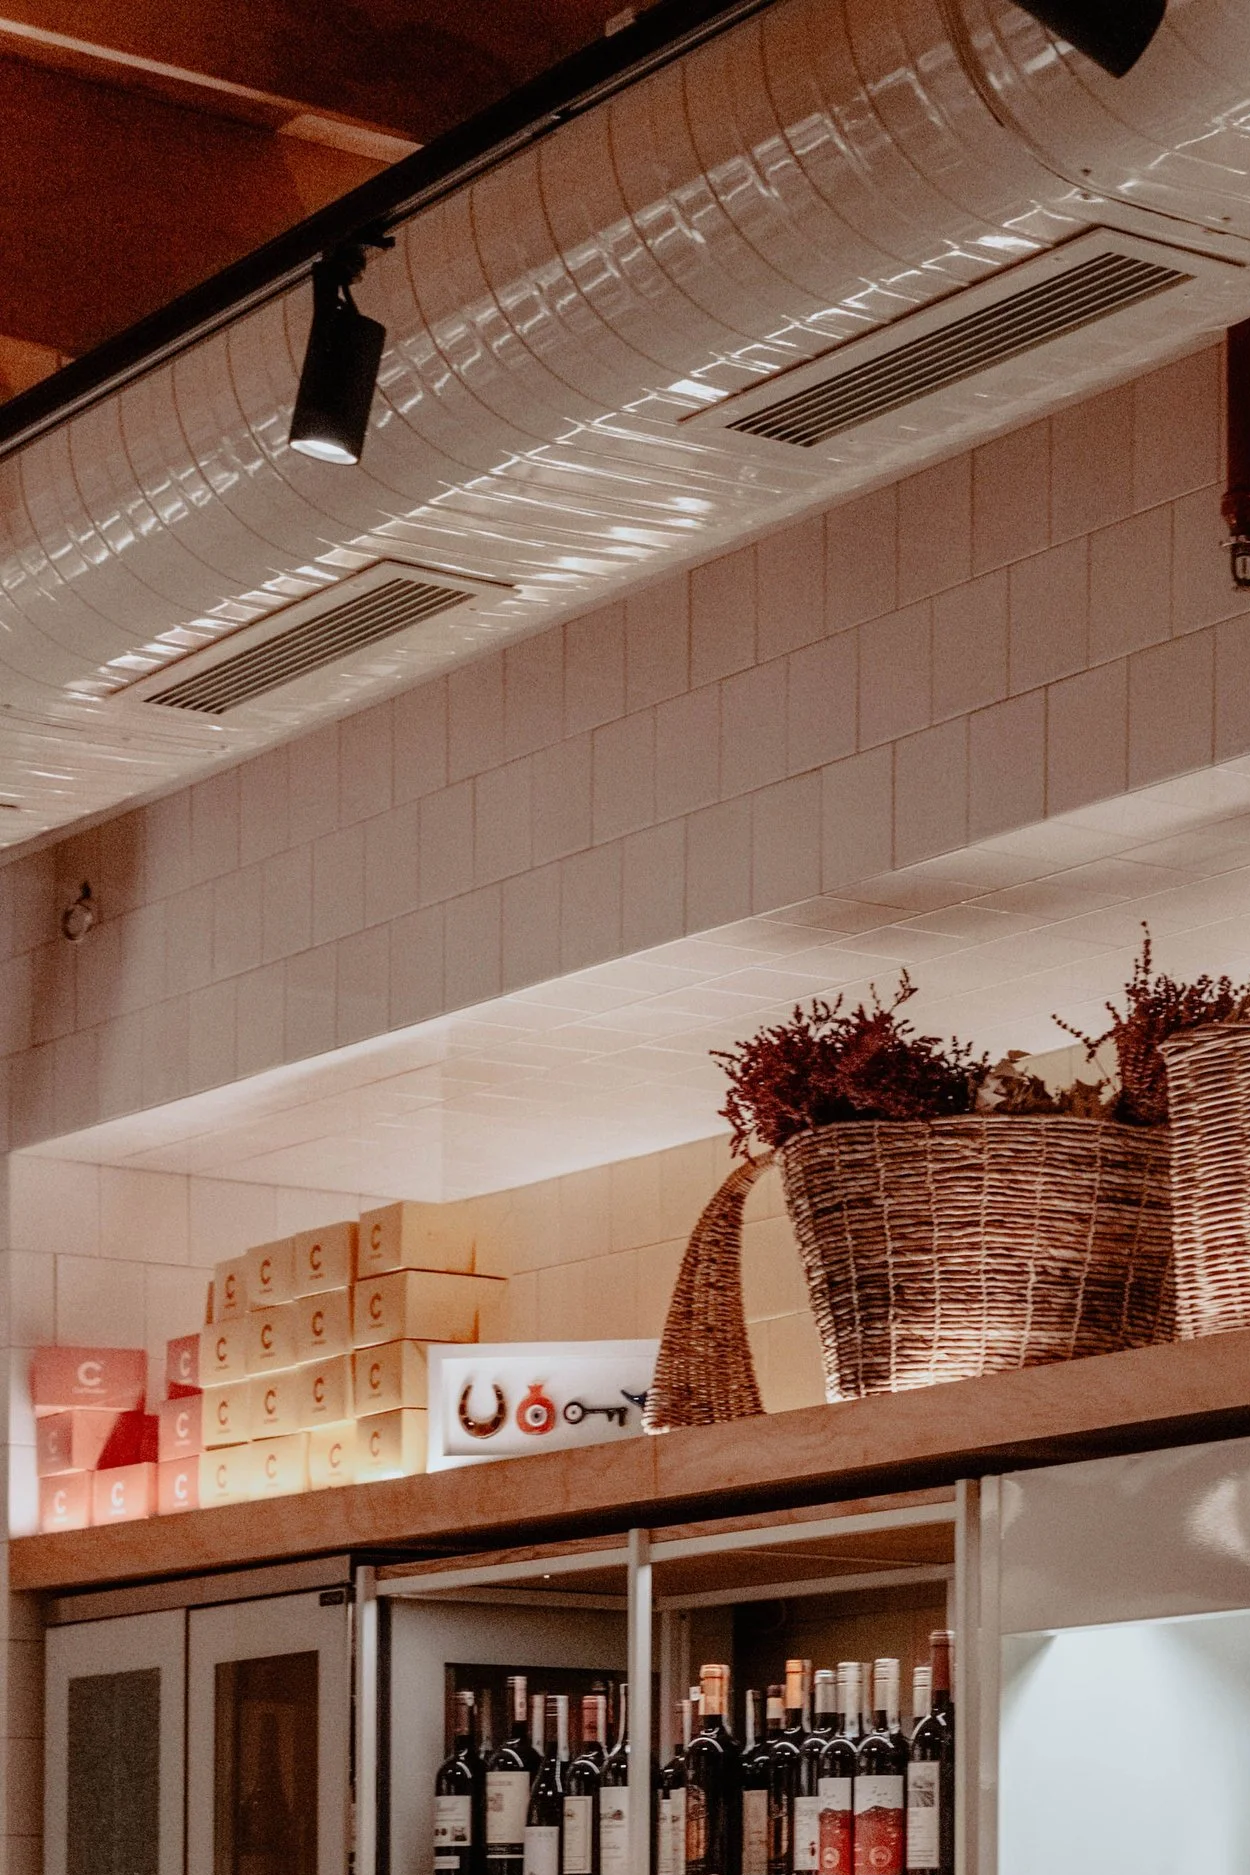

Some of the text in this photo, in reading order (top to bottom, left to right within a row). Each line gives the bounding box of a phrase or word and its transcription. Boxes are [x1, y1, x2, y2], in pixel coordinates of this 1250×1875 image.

[310, 1244, 322, 1271] C
[260, 1259, 271, 1285] C
[261, 1324, 272, 1349] C
[312, 1311, 324, 1337] C
[77, 1361, 103, 1386] C
[180, 1351, 191, 1377] C
[264, 1389, 276, 1415] C
[313, 1377, 325, 1403] C
[176, 1411, 188, 1438] C
[111, 1481, 125, 1507] C
[175, 1474, 188, 1499] C
